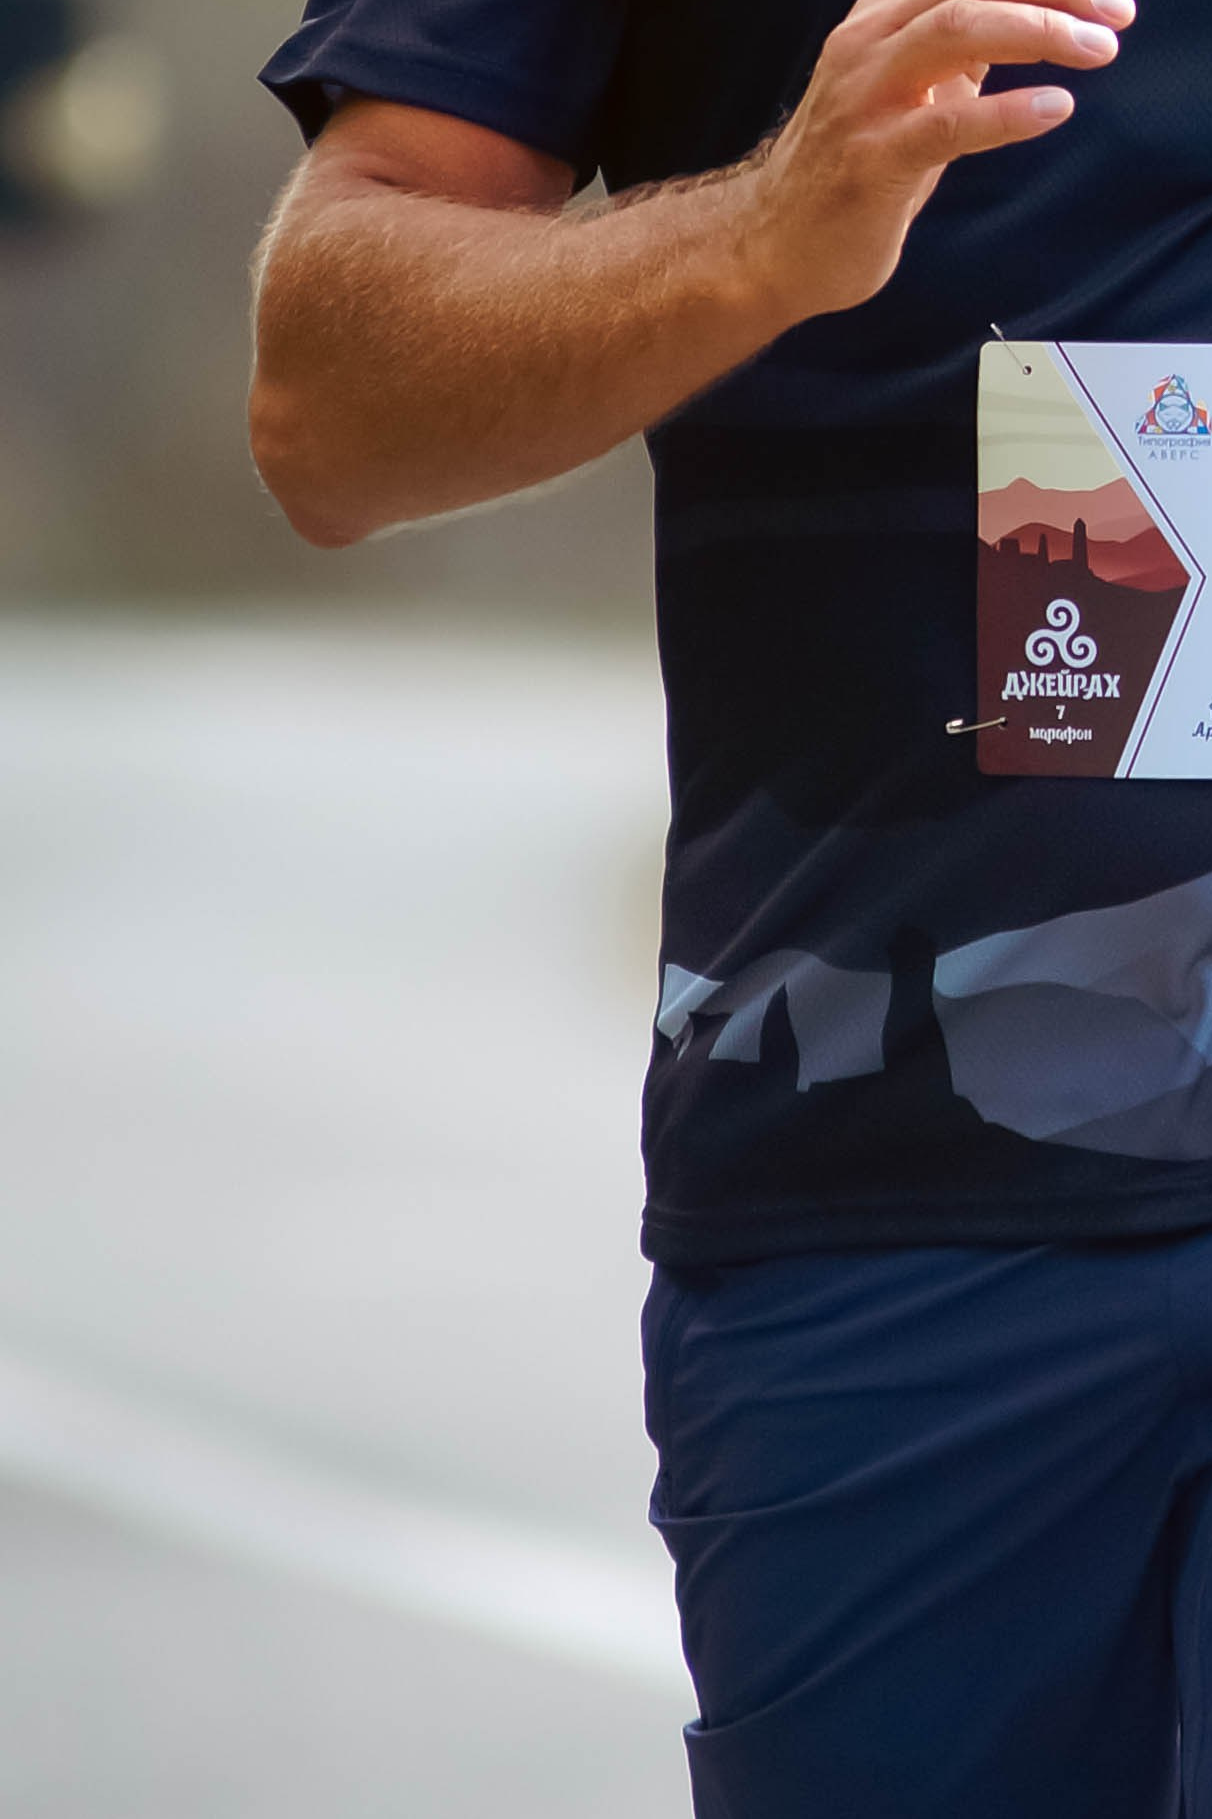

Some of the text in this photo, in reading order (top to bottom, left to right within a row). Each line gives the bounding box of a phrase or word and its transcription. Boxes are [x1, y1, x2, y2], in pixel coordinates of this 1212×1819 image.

[1001, 668, 1121, 701] ДЖЕЙРАХ
[1055, 704, 1067, 720] 7
[1028, 725, 1093, 745] марафон
